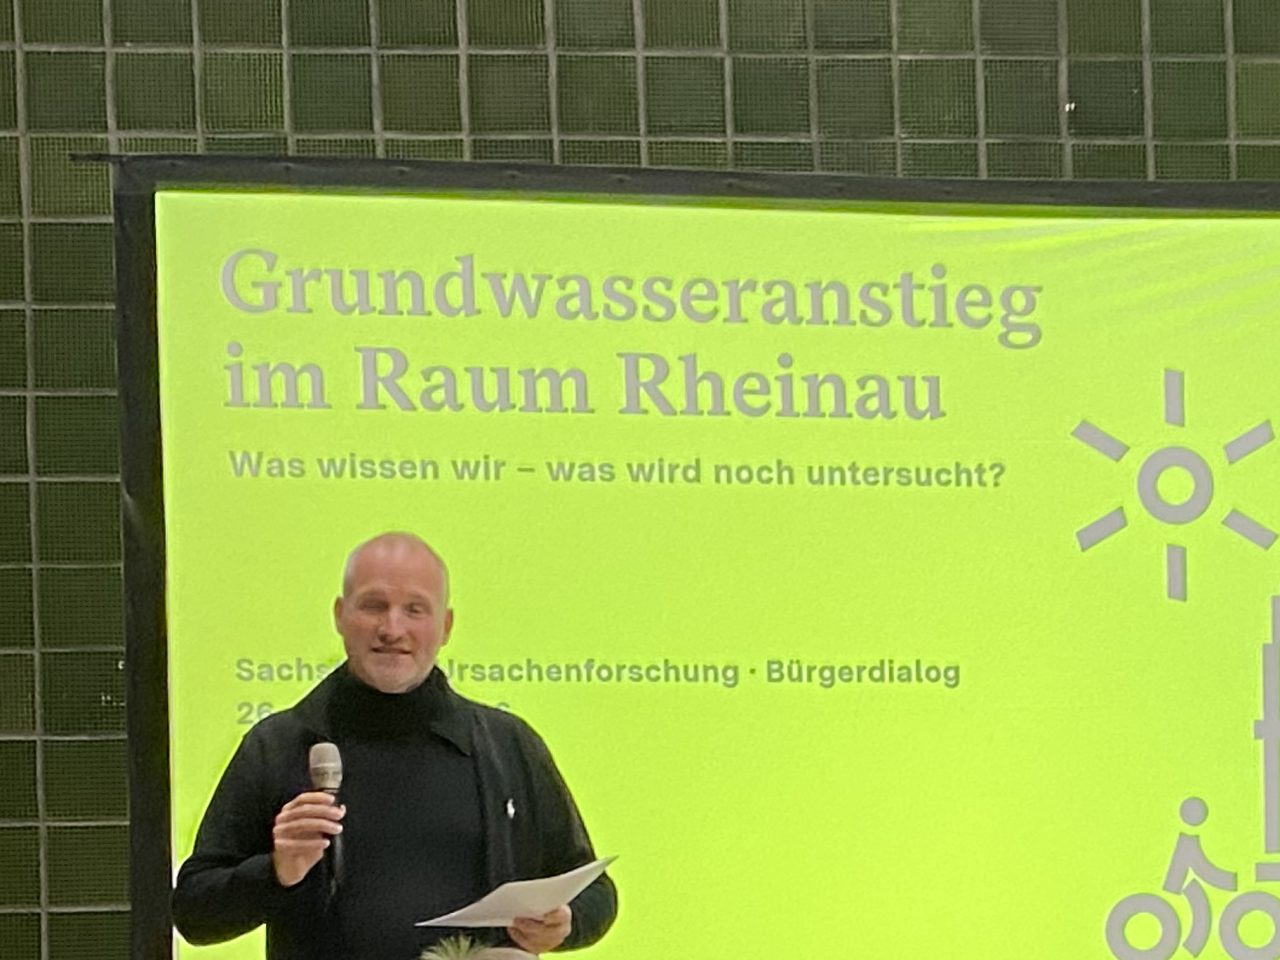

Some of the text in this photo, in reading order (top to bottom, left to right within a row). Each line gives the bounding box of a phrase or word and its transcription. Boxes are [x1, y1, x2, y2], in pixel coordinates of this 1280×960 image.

[220, 247, 1044, 350] Grundwasseranstieg
[223, 339, 947, 421] im Raum Rheinau
[229, 449, 307, 479] Was
[315, 451, 440, 481] wissen
[450, 453, 507, 482] wir
[545, 460, 616, 483] was
[625, 457, 702, 484] wird
[713, 458, 795, 486] noch
[807, 460, 1006, 488] untersucht?
[235, 656, 330, 683] Sachs
[766, 657, 961, 689] Bürgerdialog
